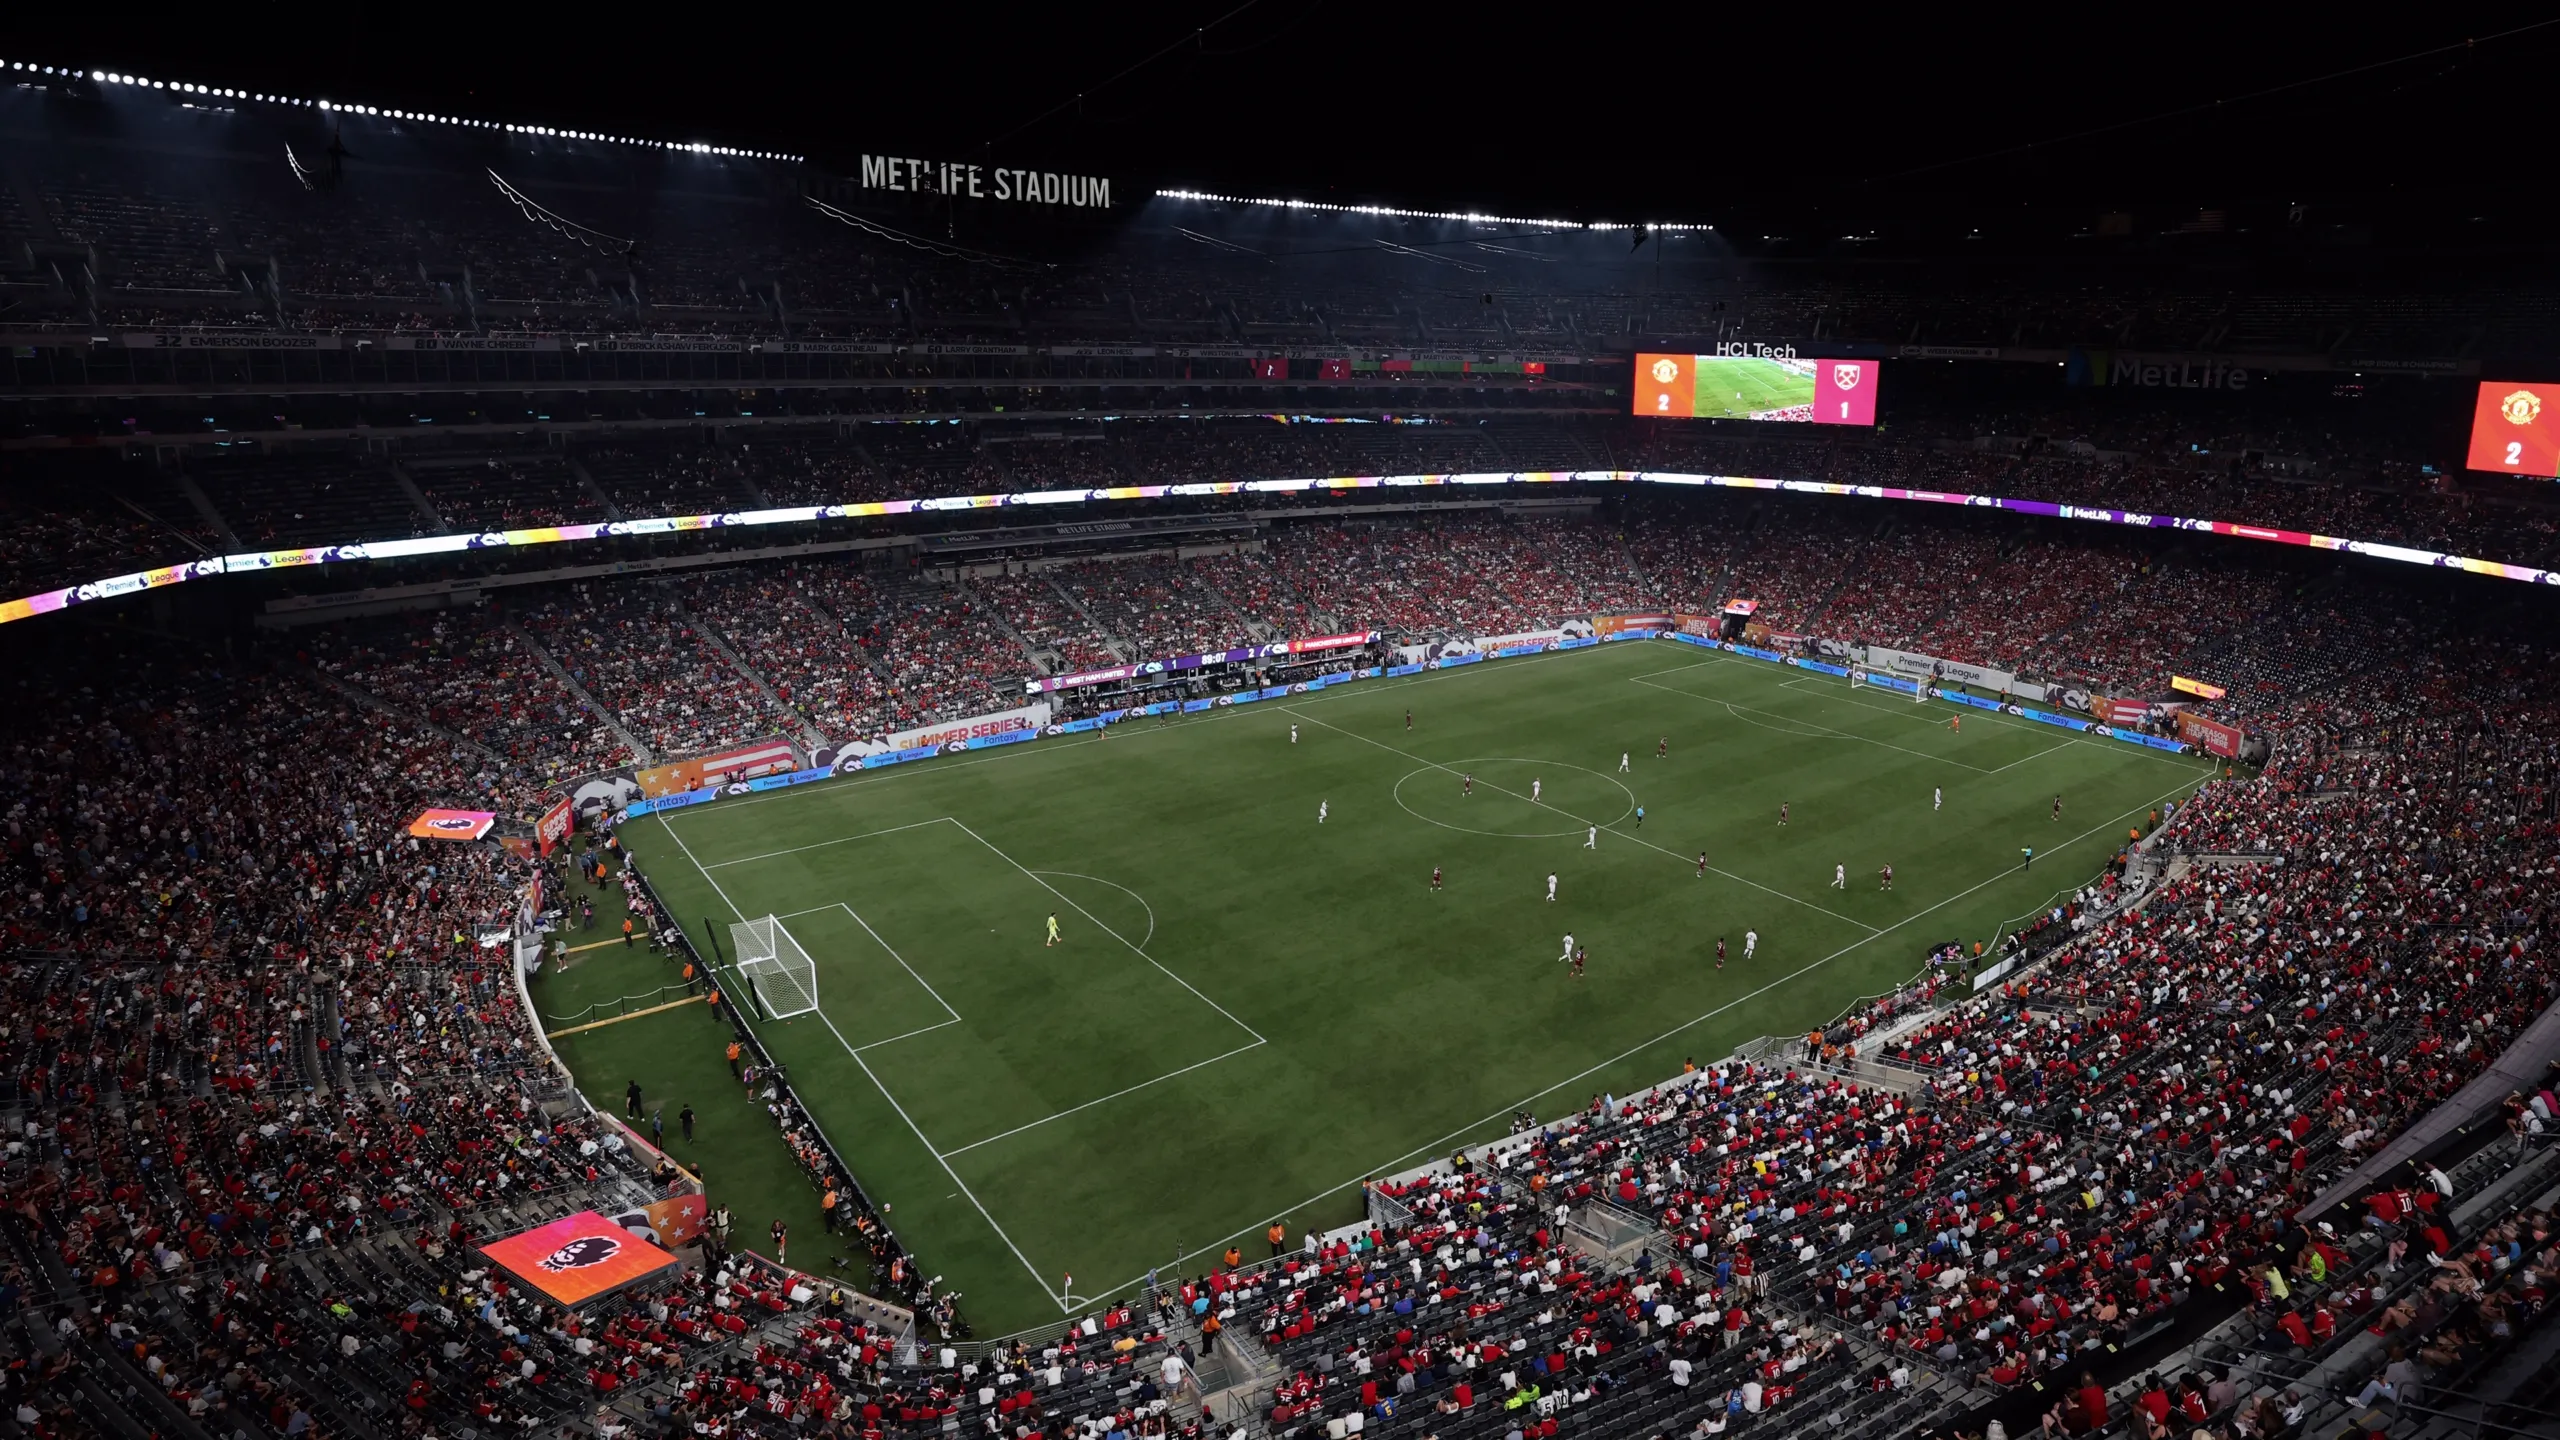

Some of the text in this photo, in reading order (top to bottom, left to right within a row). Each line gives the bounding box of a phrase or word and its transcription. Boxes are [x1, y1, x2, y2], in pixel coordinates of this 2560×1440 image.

[994, 167, 1110, 209] STADIUM
[190, 337, 259, 347] EMERSON
[263, 339, 316, 348] BOOZER
[414, 339, 536, 349] 80 WAYNE CHREBET
[598, 340, 617, 350] 60
[693, 343, 739, 351] FERGUSON
[783, 343, 877, 352] 99 MARK GASTINEAU
[927, 345, 942, 353] 60
[2111, 358, 2249, 391] MetLife
[1658, 394, 1669, 410] 2
[1840, 402, 1849, 419] 1
[2504, 441, 2523, 465] 2
[1995, 498, 2002, 507] 1
[2074, 508, 2180, 527] MetLife 89:07 2
[678, 520, 706, 528] League
[1056, 522, 1132, 535] METLIFE STADIUM
[948, 535, 980, 543] MetLife
[227, 553, 314, 568] emier League
[105, 571, 180, 592] Premier League
[1687, 619, 1709, 628] NEW
[1305, 635, 1363, 648] MANCHESTER UNITED
[1480, 636, 1559, 652] SUMMER SERIES
[1201, 652, 1227, 665] 89:07
[1248, 648, 1255, 658] 2
[1171, 659, 1177, 669] 1
[1450, 656, 1471, 664] Fantasy
[1809, 663, 1834, 673] Fantasy
[1899, 656, 1980, 680] Premier League
[1066, 670, 1126, 685] WEST HAM UNITED
[1246, 689, 1273, 700] Fanasy
[2038, 712, 2069, 726] Fantasy
[899, 717, 1022, 750] SUMMER SERIES
[2187, 721, 2228, 741] THE SEASON
[984, 733, 1019, 745] Fantasy
[2122, 733, 2168, 748] Premier League
[2210, 737, 2229, 749] HERE
[874, 751, 924, 765] Premier League
[763, 772, 819, 787] Premier League
[646, 794, 692, 812] Fantasy
[543, 806, 569, 836] SUMMER
[2400, 1197, 2413, 1213] 10
[1229, 1277, 1238, 1286] 18
[1377, 1285, 1385, 1294] 18
[1120, 1312, 1129, 1323] 17
[692, 1326, 701, 1336] 23
[752, 1350, 759, 1360] 8
[1772, 1368, 1781, 1379] 10
[725, 1382, 732, 1393] 6
[1300, 1386, 1307, 1396] 6
[1557, 1395, 1567, 1405] 10
[1771, 1394, 1780, 1405] 10
[777, 1402, 785, 1413] 10
[1544, 1402, 1552, 1412] 5
